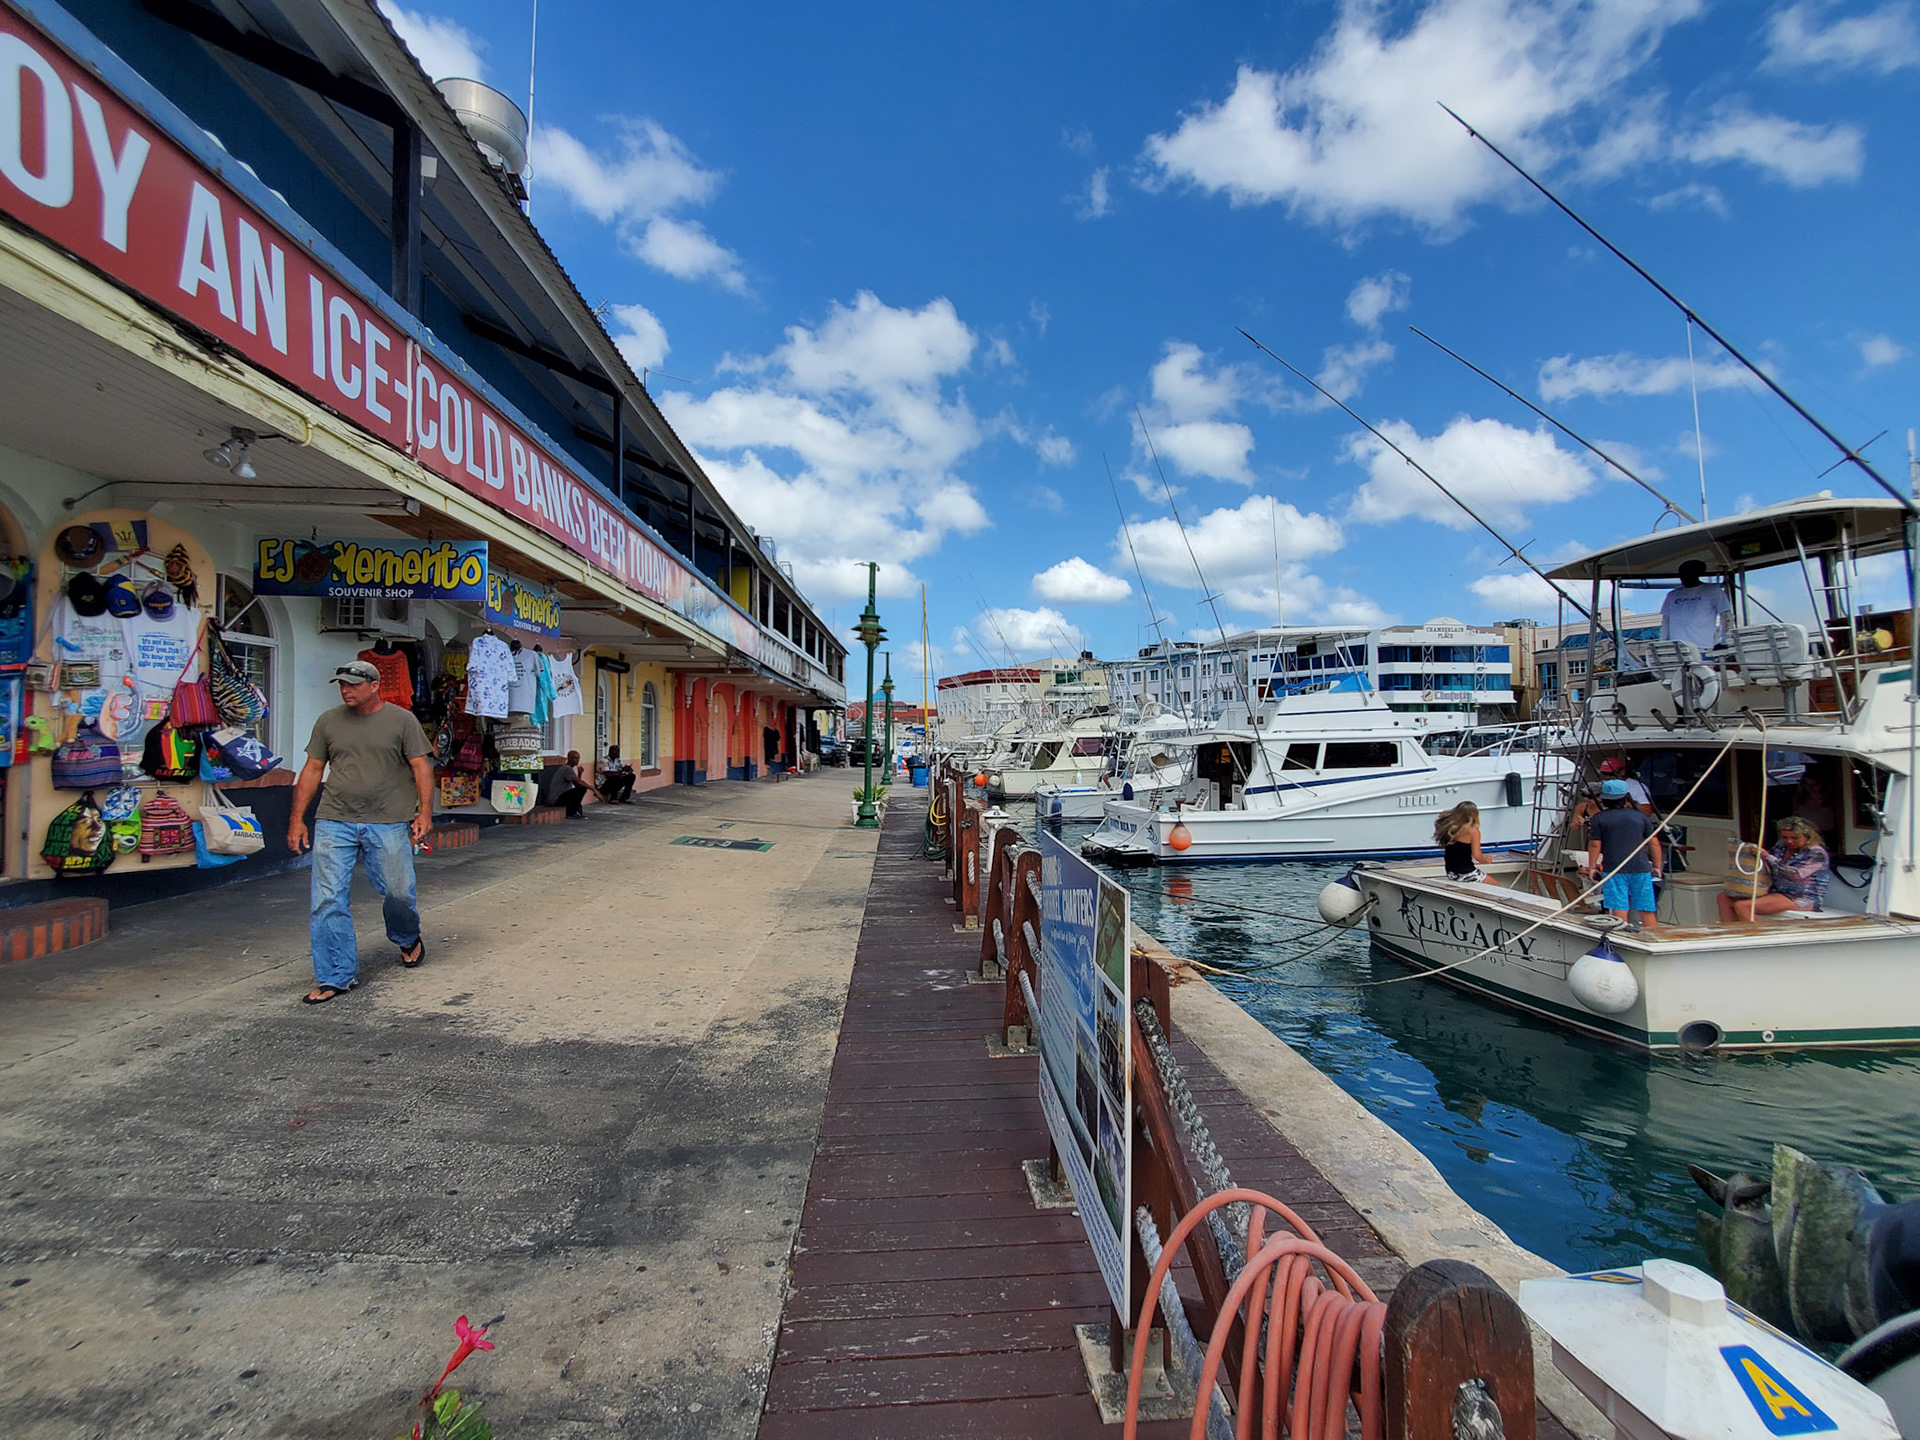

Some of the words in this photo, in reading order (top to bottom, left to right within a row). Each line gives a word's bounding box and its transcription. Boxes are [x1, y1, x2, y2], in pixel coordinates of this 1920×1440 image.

[178, 181, 288, 356] AN
[509, 434, 587, 545] BANKS
[587, 497, 627, 575] BEER
[627, 528, 670, 600] TODAY!
[259, 539, 295, 582] EJ
[332, 541, 483, 590] Memento
[328, 586, 383, 598] SOUVENIR
[385, 588, 414, 598] SHOP
[488, 574, 502, 612] EJ
[513, 619, 532, 631] SOUVENIR
[494, 738, 541, 749] BARBADOS
[234, 830, 263, 839] BARBADOS
[1062, 888, 1095, 928] CHARTERS
[1416, 904, 1537, 963] LEGACY
[1740, 1357, 1813, 1420] A
